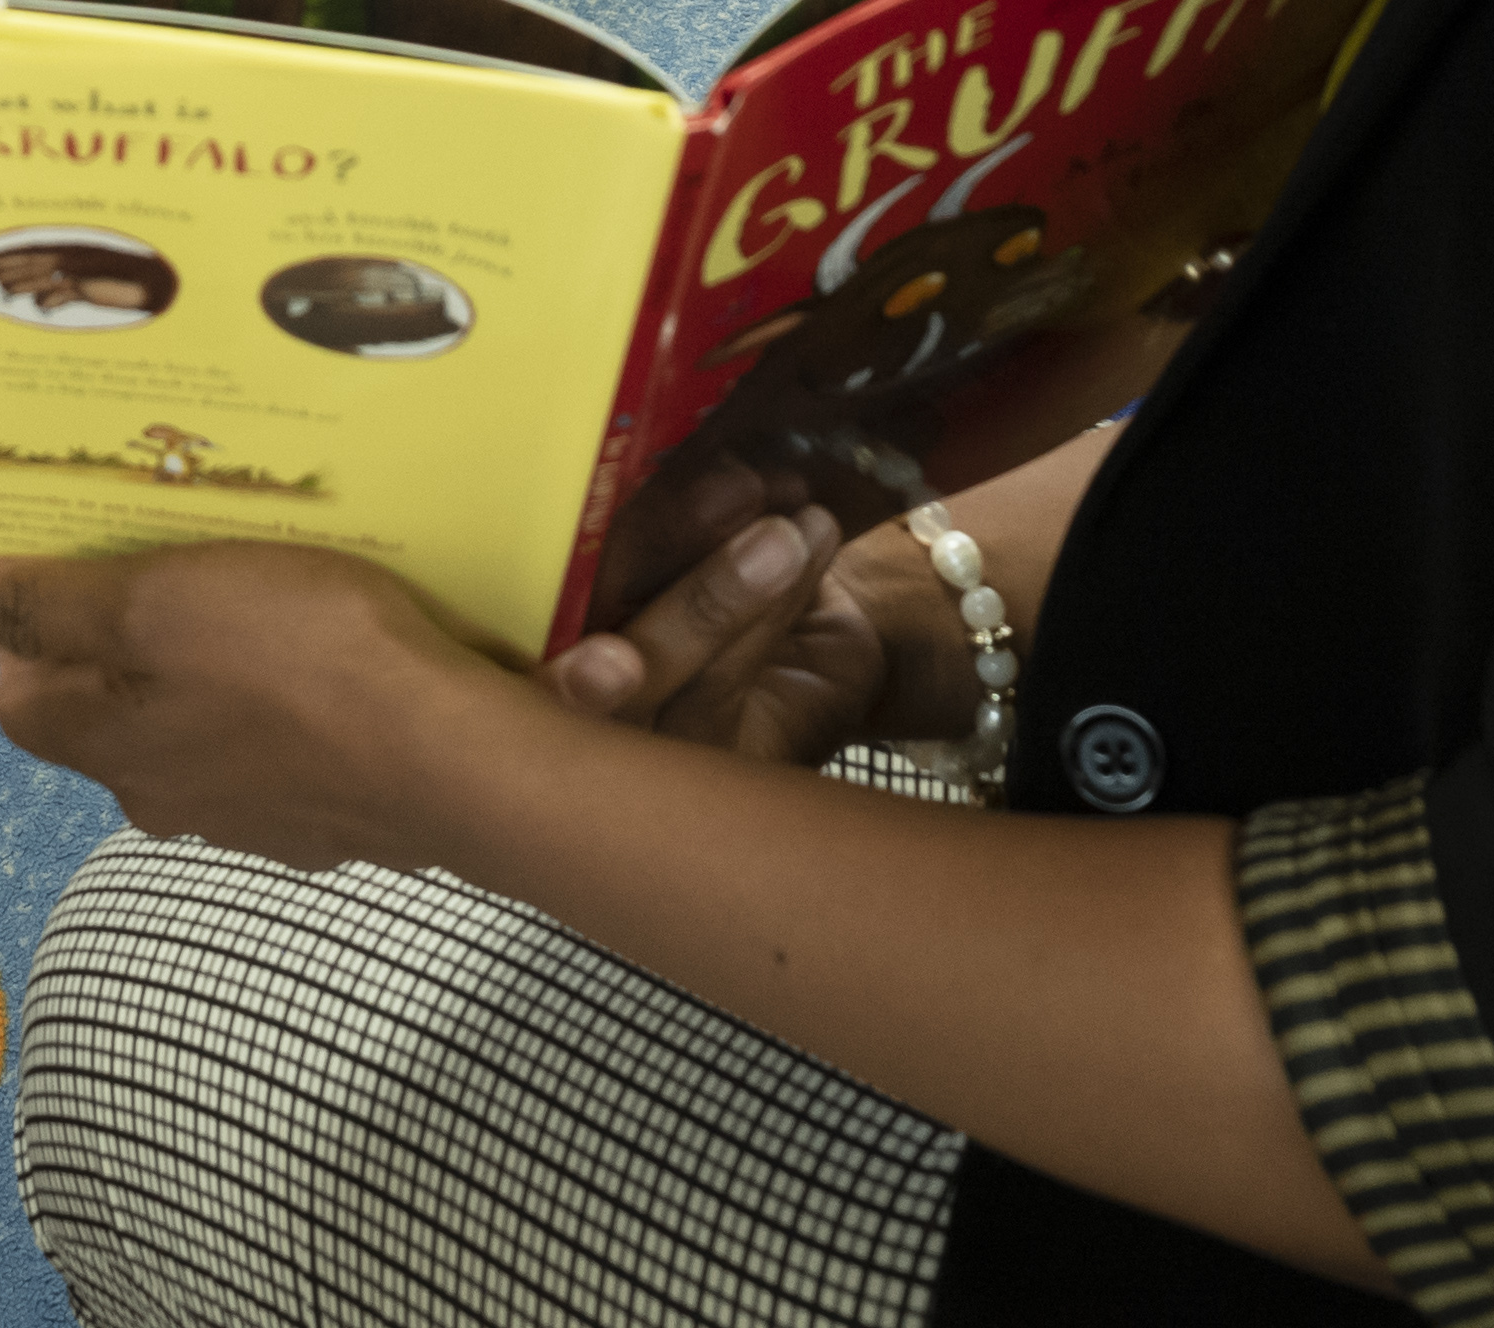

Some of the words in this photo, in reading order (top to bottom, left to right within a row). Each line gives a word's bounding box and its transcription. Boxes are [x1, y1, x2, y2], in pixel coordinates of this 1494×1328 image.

[830, 0, 998, 106] THE
[48, 90, 152, 120] what
[172, 99, 205, 123] is
